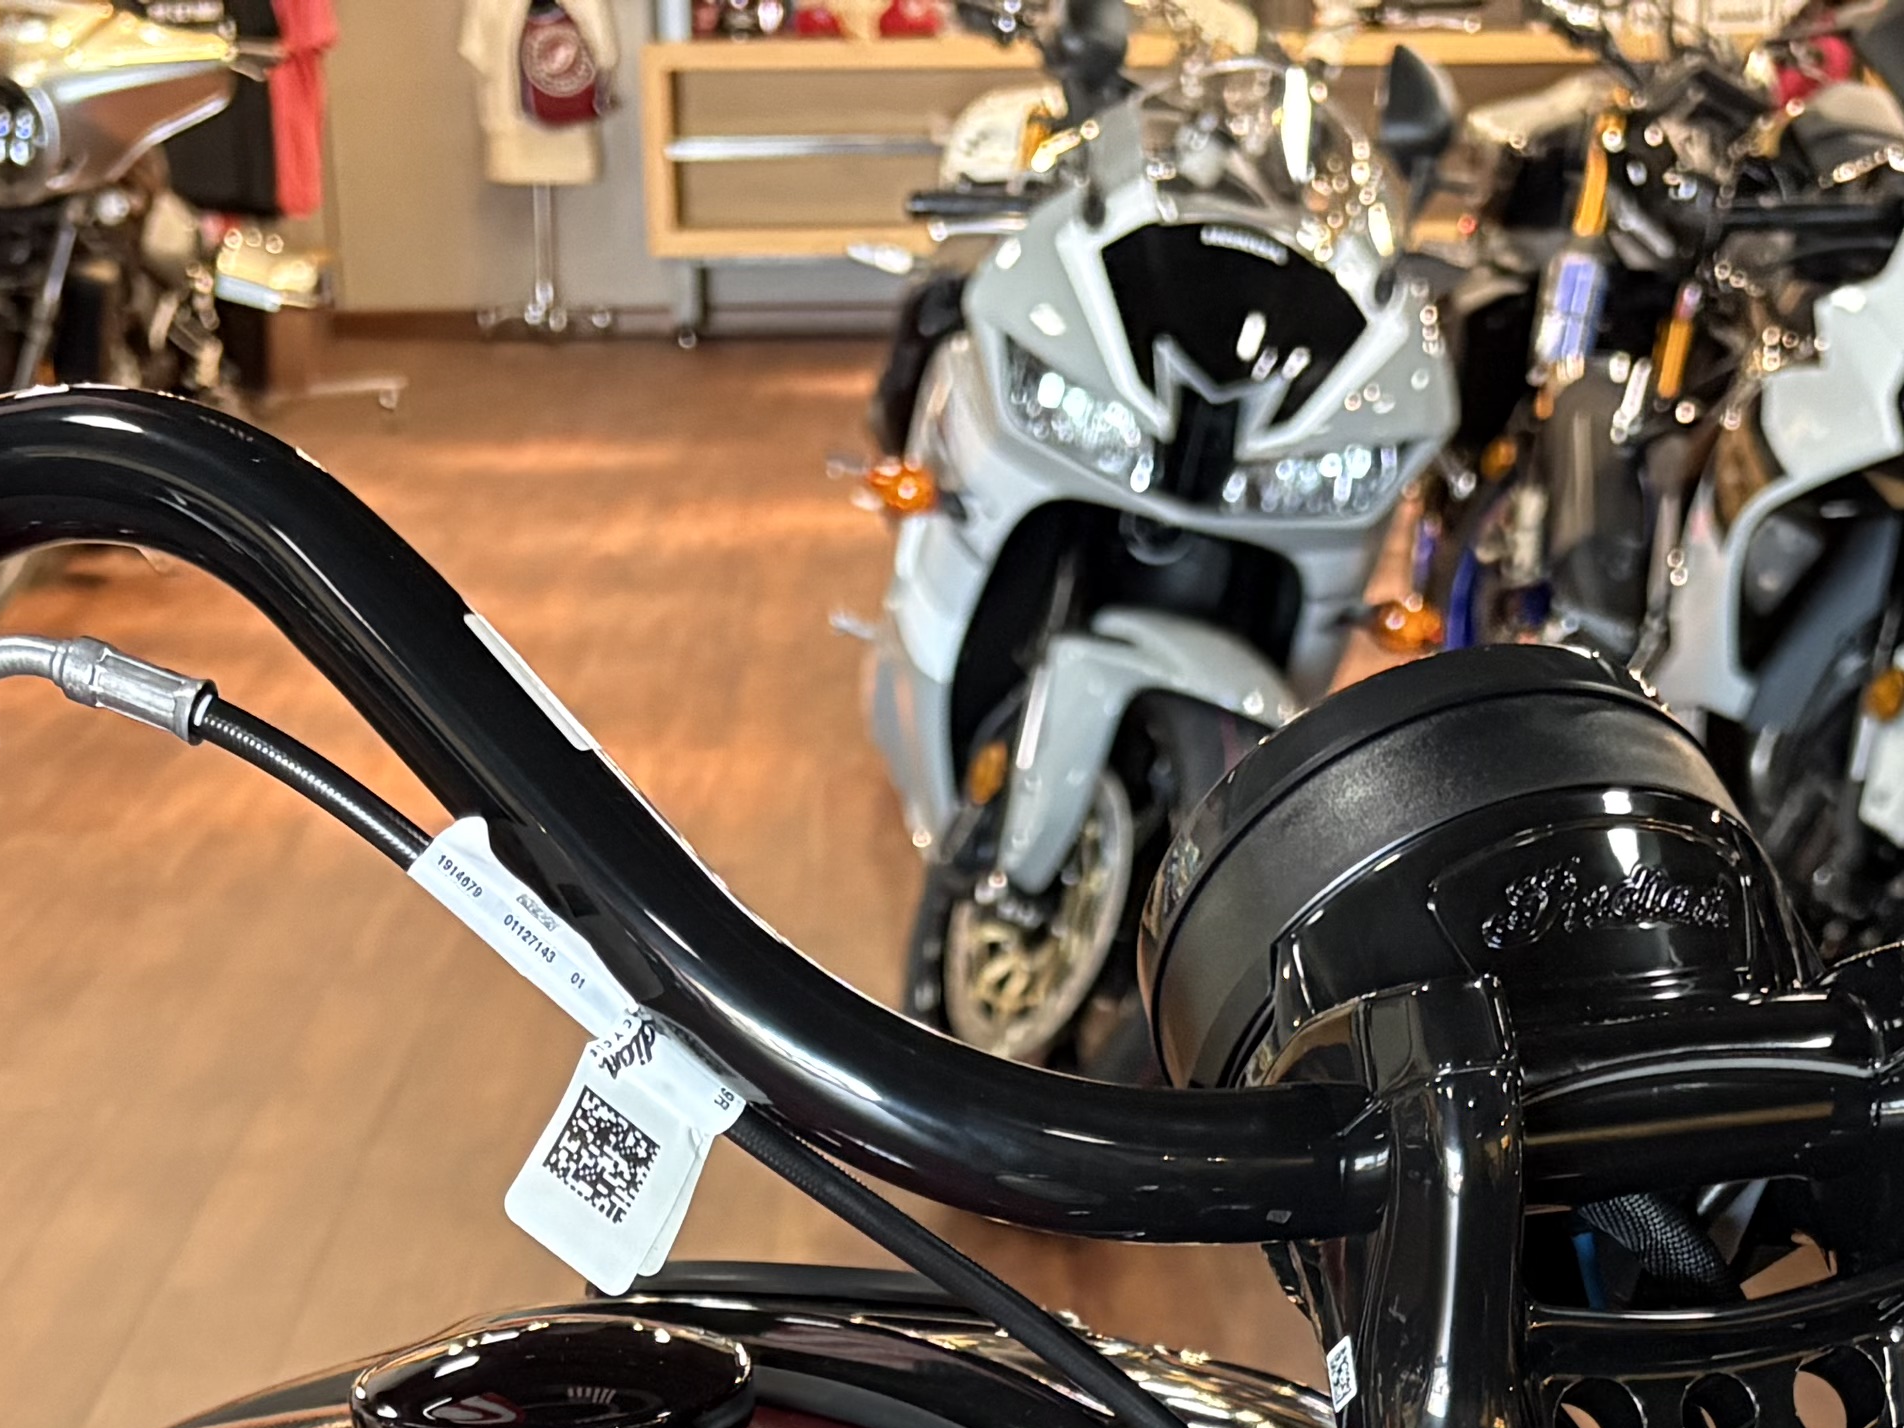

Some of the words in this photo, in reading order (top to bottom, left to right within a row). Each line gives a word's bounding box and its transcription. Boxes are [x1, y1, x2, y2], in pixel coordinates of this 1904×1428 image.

[503, 914, 557, 964] 01127143
[570, 972, 586, 990] 01
[598, 1020, 657, 1080] dian
